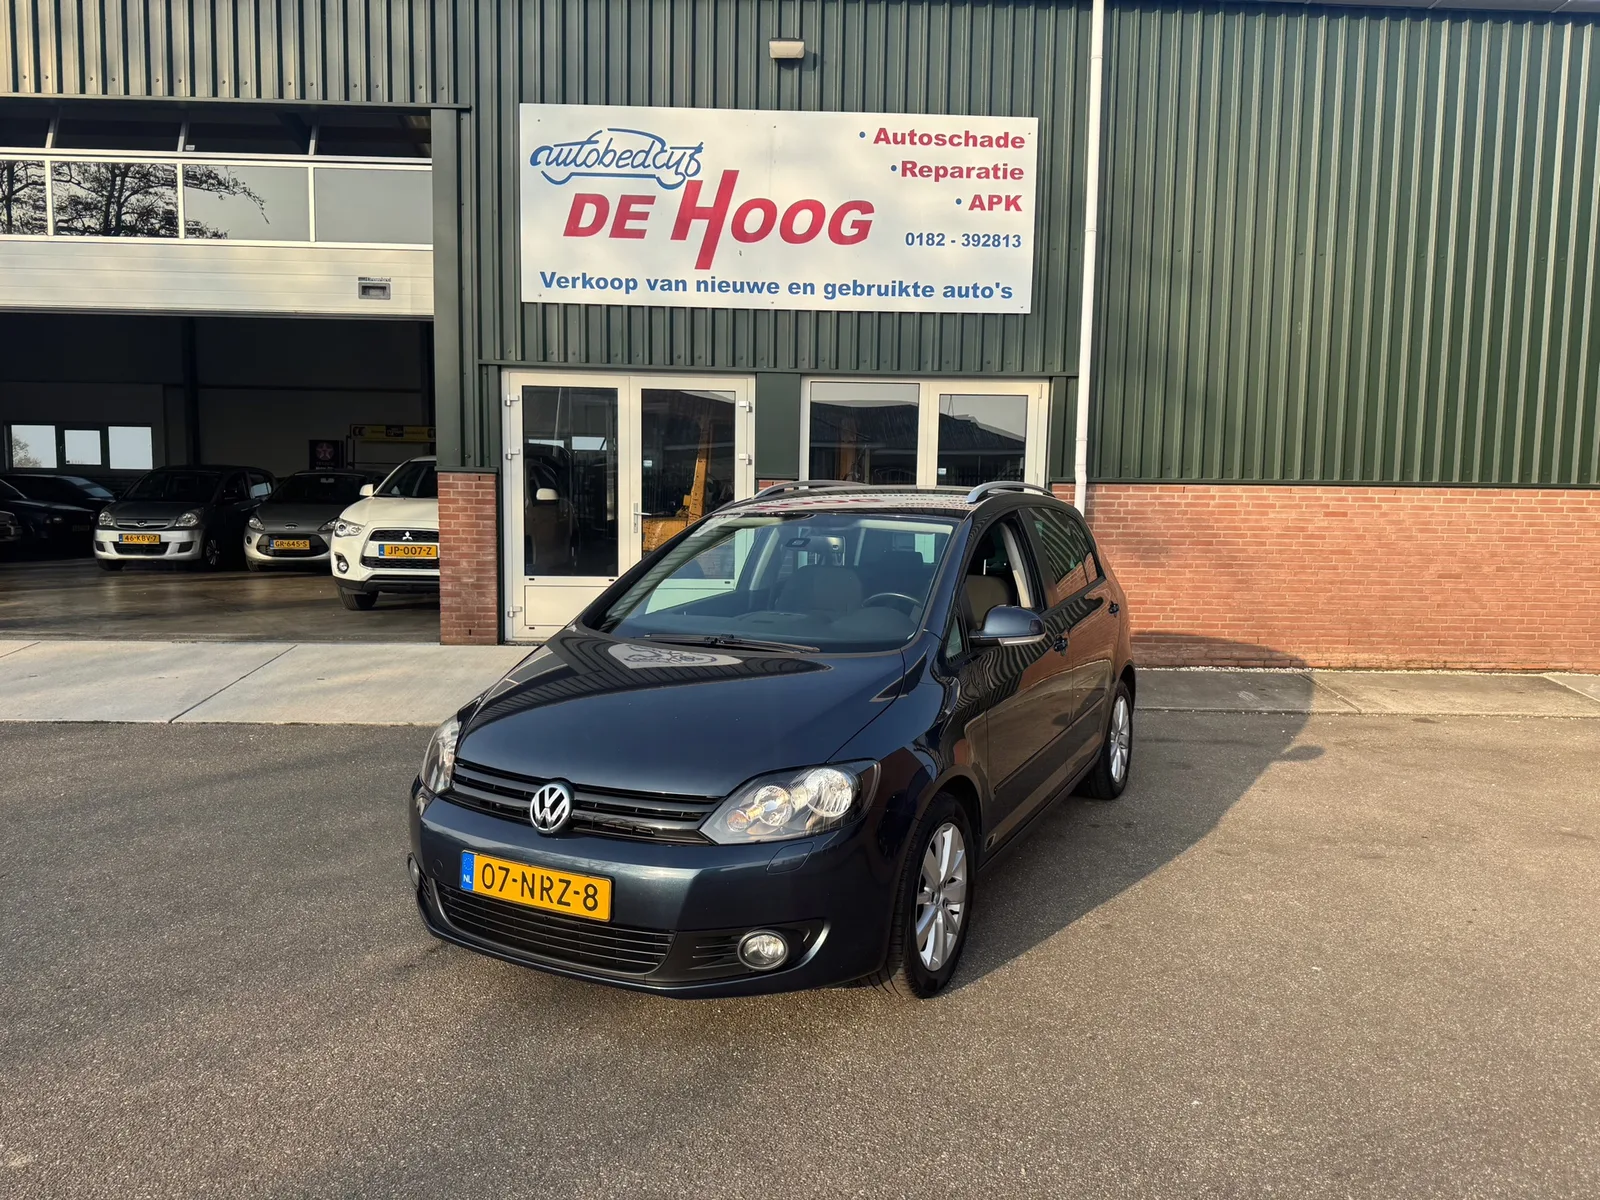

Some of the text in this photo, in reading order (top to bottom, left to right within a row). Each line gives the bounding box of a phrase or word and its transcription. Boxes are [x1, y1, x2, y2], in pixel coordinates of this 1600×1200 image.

[874, 128, 1026, 149] Autoschade
[901, 161, 1024, 182] Reparatie
[969, 194, 1022, 212] APK
[563, 169, 875, 271] DE HOOG
[905, 232, 946, 247] 0182
[962, 233, 1022, 249] 392813
[540, 271, 1014, 300] Verkoop van nieuwe en gebruikte auto's
[124, 534, 157, 542] 46-KBV-7
[274, 540, 308, 548] GR-645-S
[388, 545, 432, 556] JP-007-Z
[462, 862, 599, 912] NL 07-NRZ-8
